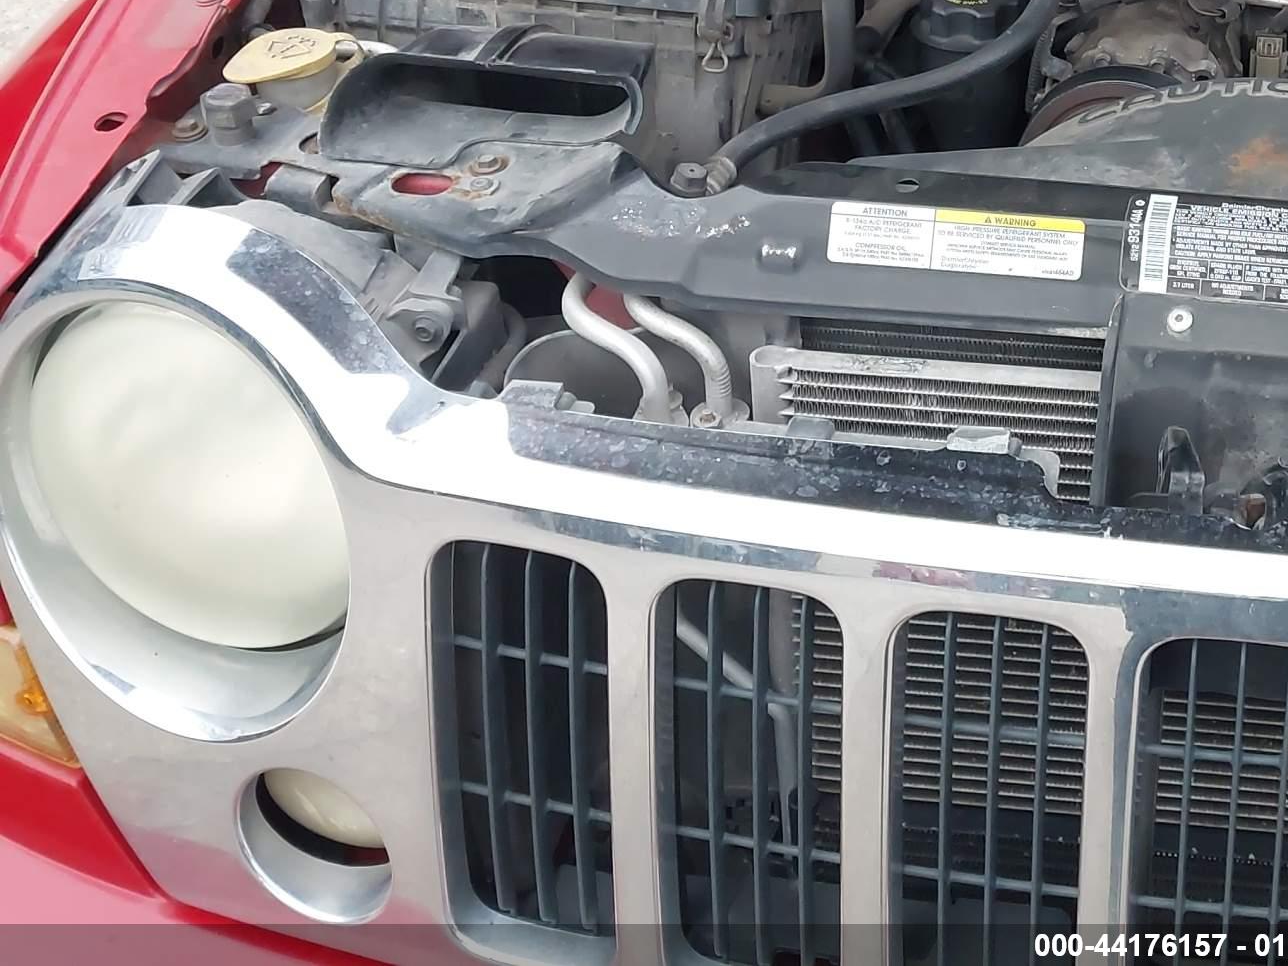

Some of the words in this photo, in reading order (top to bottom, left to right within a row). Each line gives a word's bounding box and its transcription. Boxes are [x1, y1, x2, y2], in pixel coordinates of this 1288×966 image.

[863, 206, 908, 218] ATTENTION
[1191, 205, 1230, 214] VEHICLE
[1232, 208, 1278, 218] EMISSION
[995, 217, 1037, 228] WARNING
